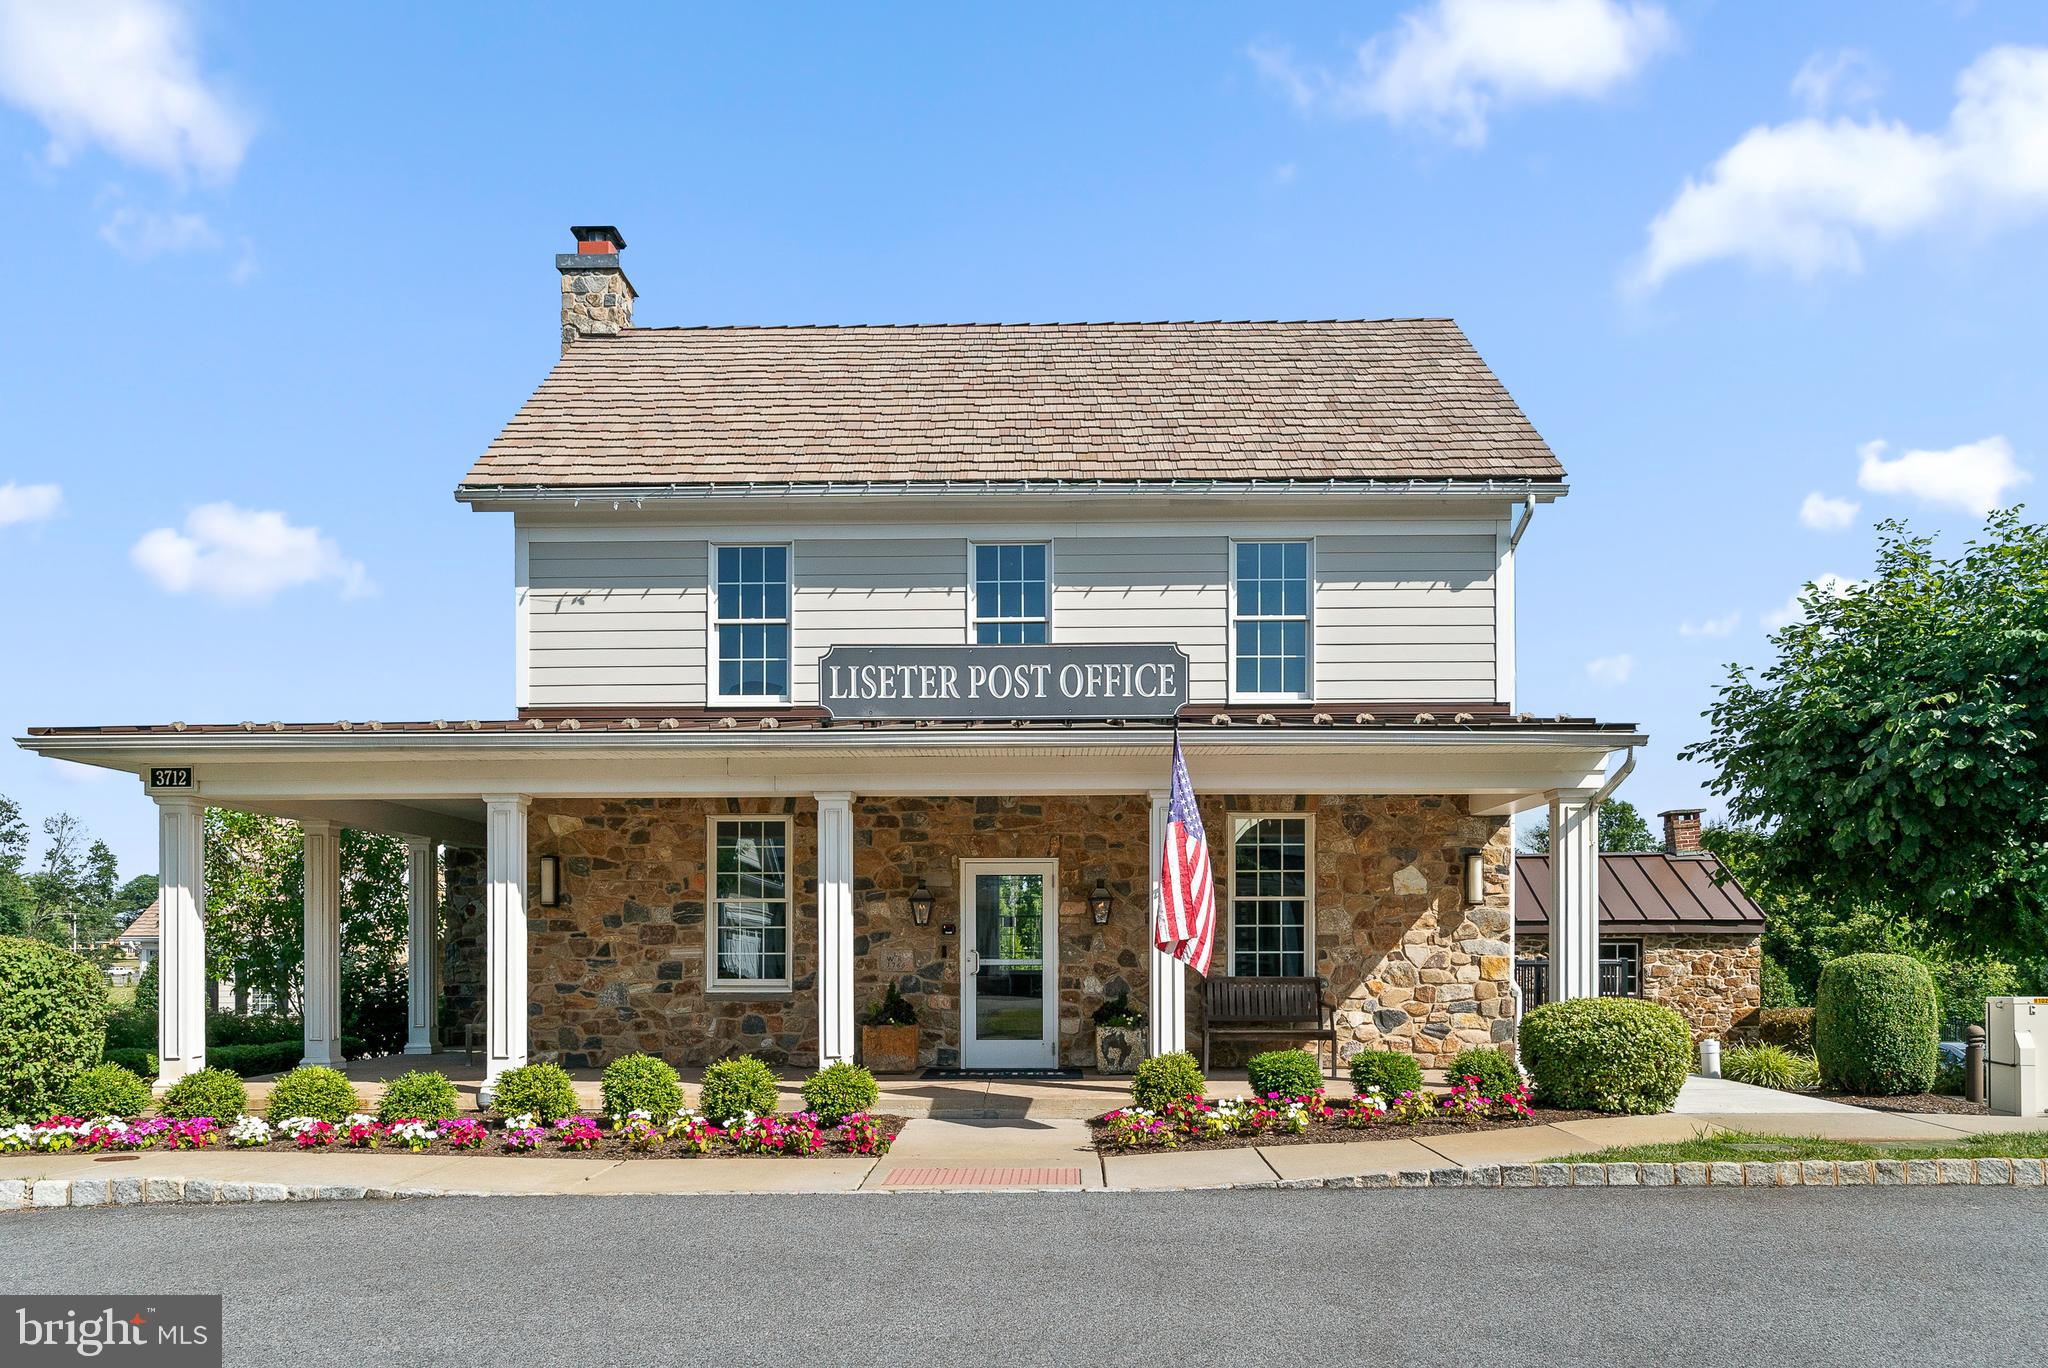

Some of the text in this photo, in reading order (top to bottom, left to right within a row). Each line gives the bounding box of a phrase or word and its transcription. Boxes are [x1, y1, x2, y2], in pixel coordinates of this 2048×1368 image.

[829, 663, 1177, 700] LISETER POST OFFICE
[156, 770, 187, 786] 3712
